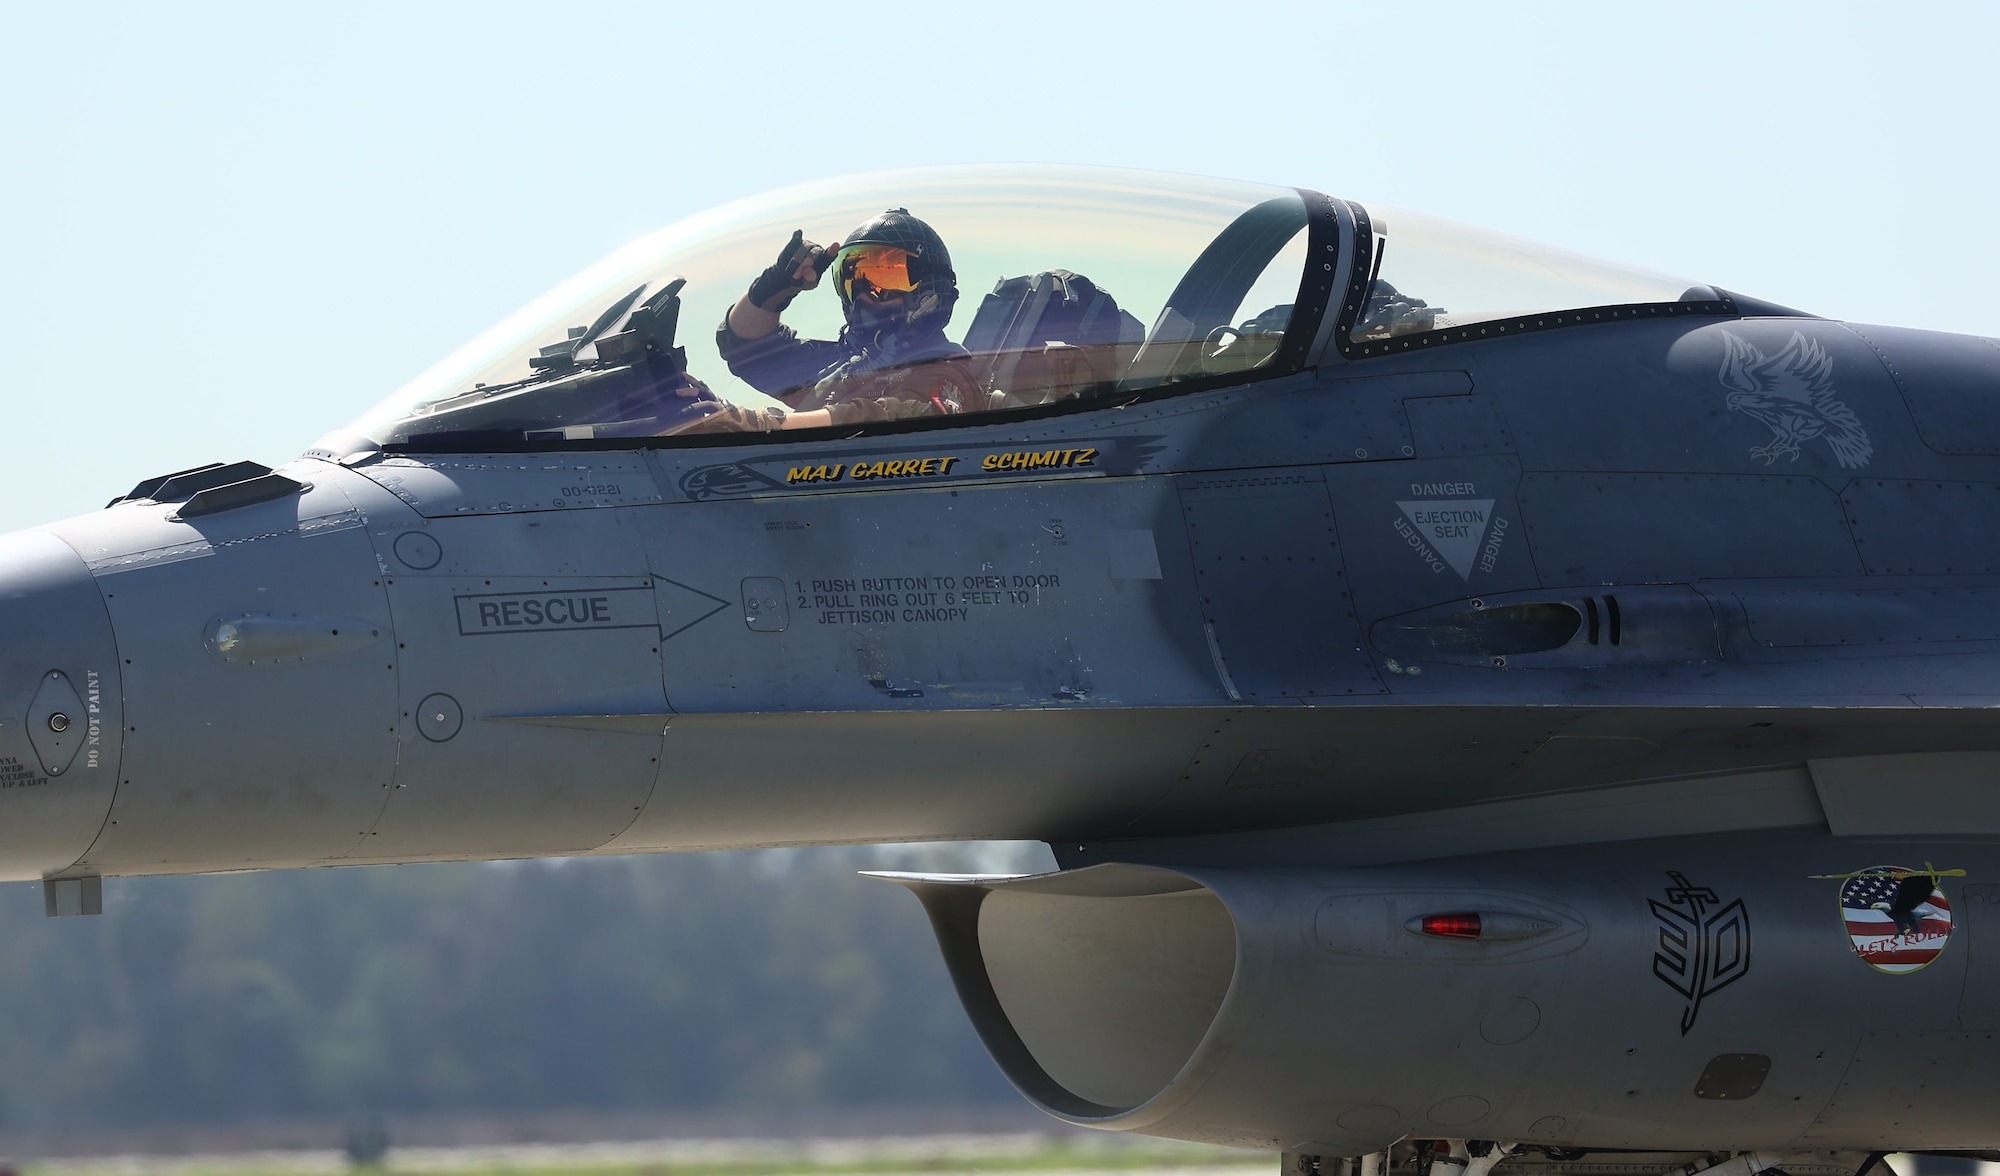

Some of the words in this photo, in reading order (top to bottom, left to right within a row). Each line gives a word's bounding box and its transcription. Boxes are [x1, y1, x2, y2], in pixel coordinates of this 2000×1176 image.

[786, 463, 845, 485] MAJ
[849, 456, 960, 481] GARRET
[981, 447, 1098, 473] SCHMITZ
[1411, 482, 1476, 496] DANGER
[1414, 510, 1484, 524] EJECTION
[1434, 525, 1469, 539] SEAT
[1393, 516, 1445, 574] DANGER
[1479, 516, 1509, 573] DANGER
[794, 580, 806, 593] 1.
[812, 579, 856, 593] PUSH
[862, 576, 928, 592] BUTTON
[933, 576, 956, 590] TO
[963, 575, 1007, 590] OPEN
[1013, 574, 1060, 588] DOOR
[798, 596, 811, 609] 2.
[815, 594, 858, 608] PULL
[860, 593, 899, 608] RING
[905, 592, 937, 607] OUT
[945, 592, 955, 606] 6
[962, 591, 1000, 605] FEET
[1007, 590, 1030, 605] TO
[478, 597, 611, 627] RESCUE
[818, 609, 896, 624] JETTISON
[902, 607, 969, 623] CANOPY
[87, 670, 100, 713] PAINT
[89, 717, 100, 746] NOT
[88, 749, 99, 768] DO
